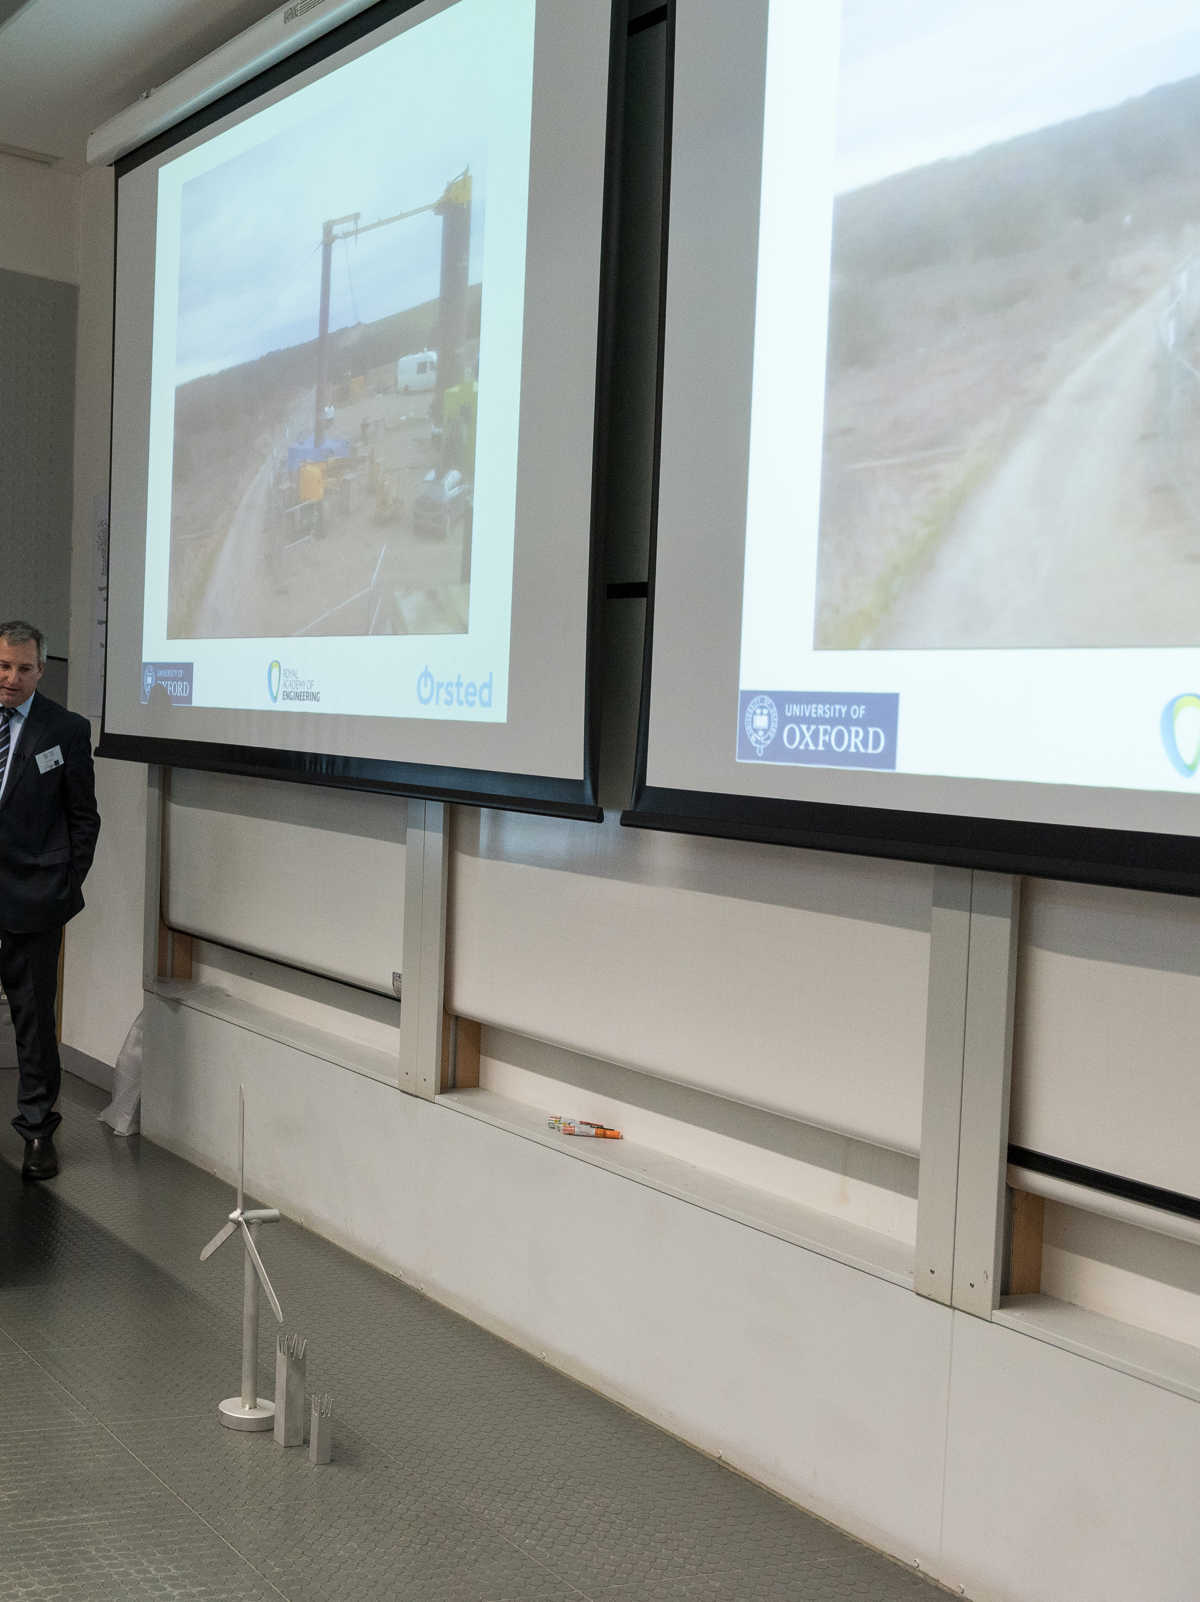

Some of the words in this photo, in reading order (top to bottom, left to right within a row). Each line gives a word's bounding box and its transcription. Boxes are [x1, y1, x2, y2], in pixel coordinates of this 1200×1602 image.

[282, 690, 321, 702] ENGINEERING
[785, 703, 848, 719] UNIVERSITY
[850, 705, 866, 719] OF
[783, 723, 885, 754] OXFORD
